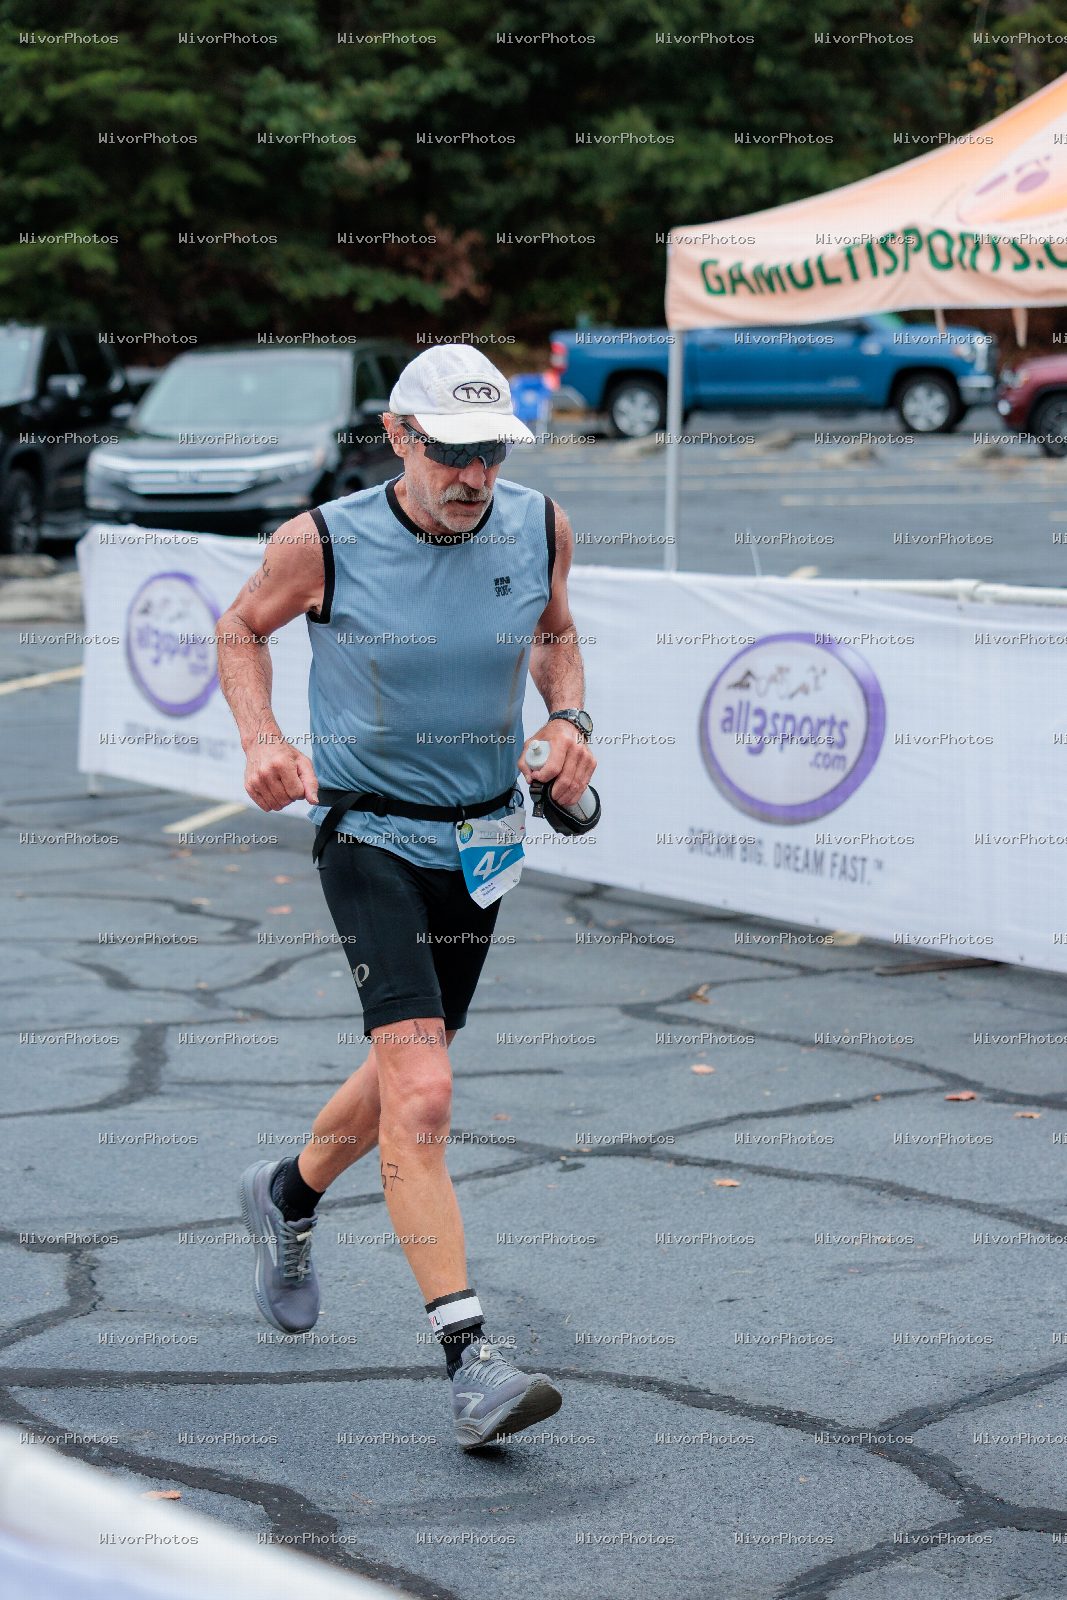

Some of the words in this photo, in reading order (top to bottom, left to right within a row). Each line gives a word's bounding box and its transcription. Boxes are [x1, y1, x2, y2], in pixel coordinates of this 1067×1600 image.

[461, 387, 493, 400] TYR
[720, 701, 849, 756] all3sports
[773, 842, 825, 877] DREAM
